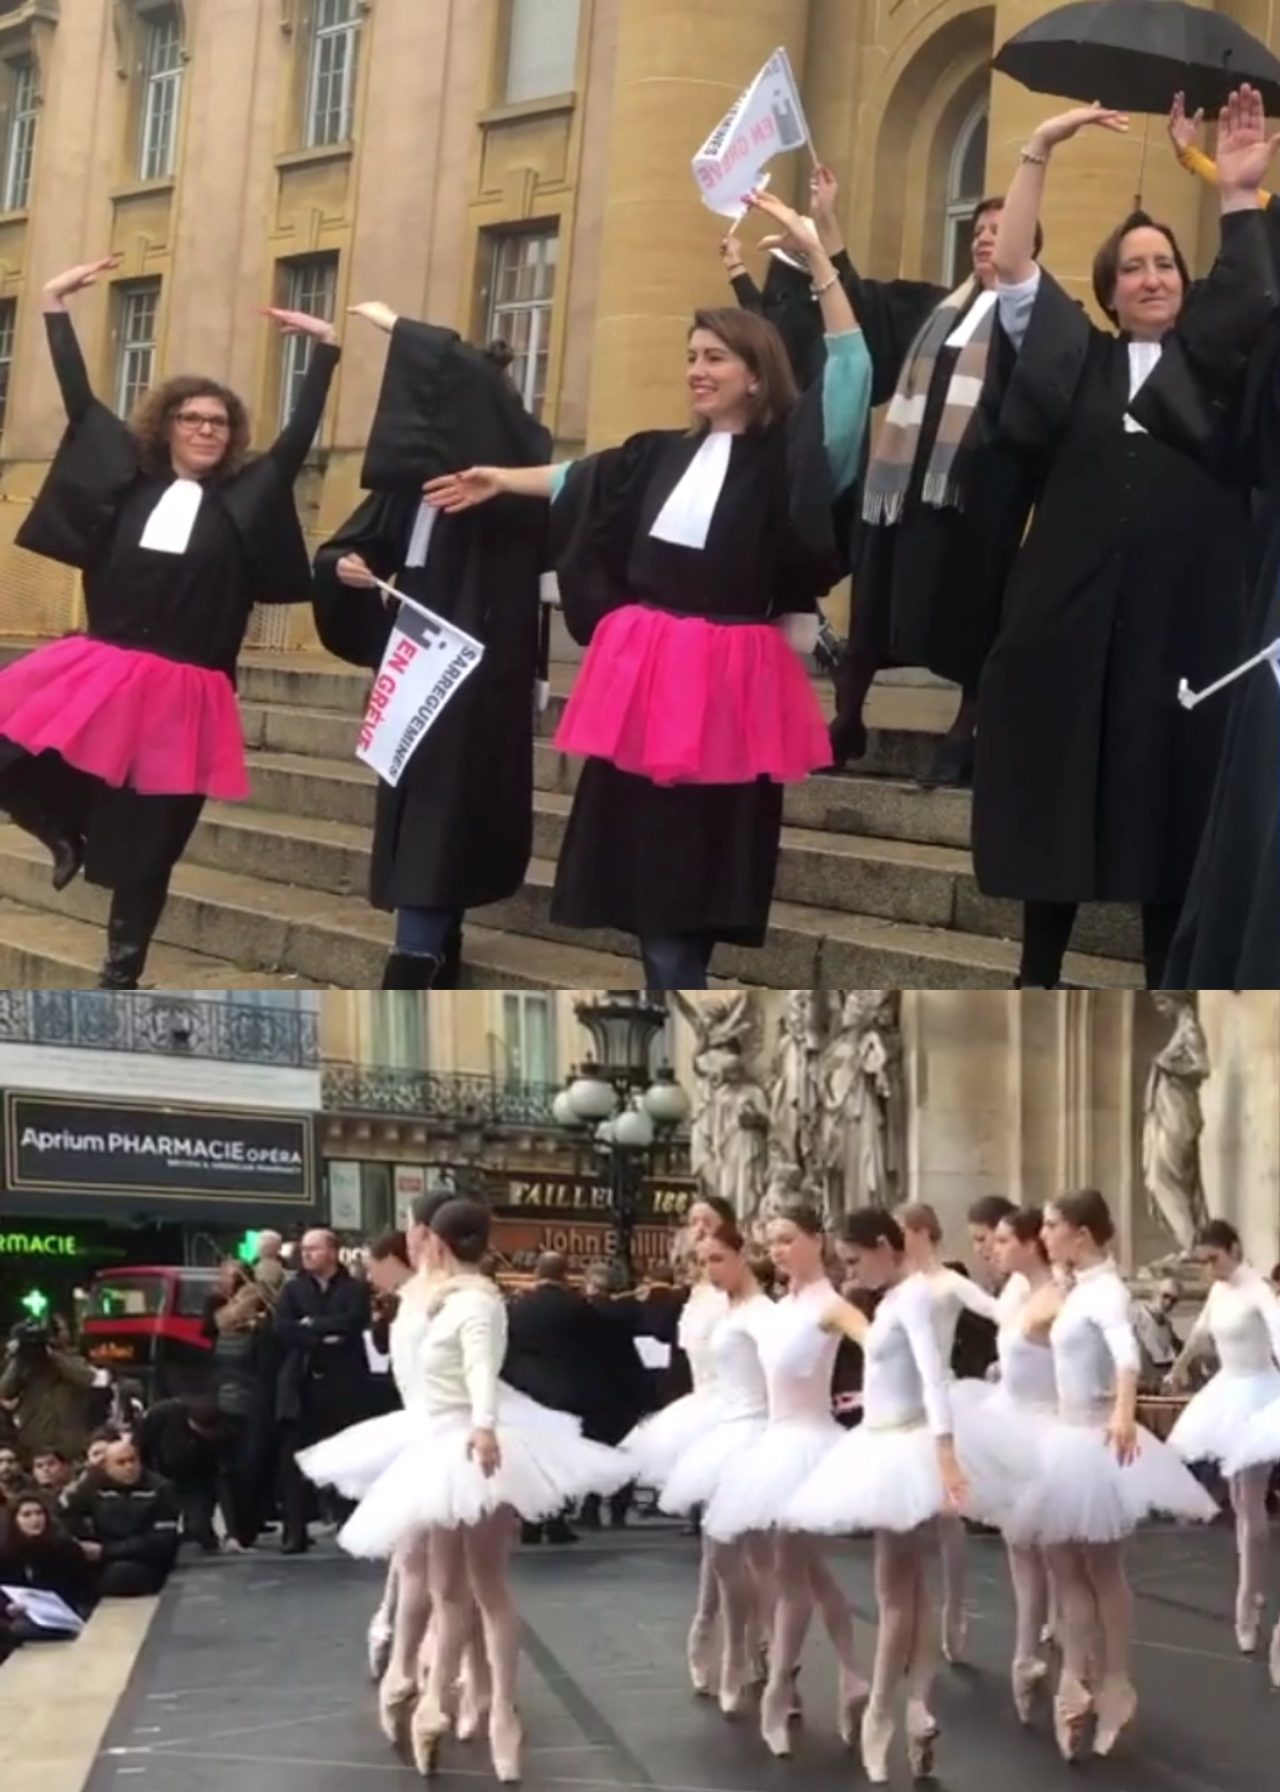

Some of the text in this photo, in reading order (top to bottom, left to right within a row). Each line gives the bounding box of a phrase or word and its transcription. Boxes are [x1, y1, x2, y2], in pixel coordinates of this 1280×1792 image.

[386, 638, 419, 676] EN
[388, 645, 478, 778] SARREGUEMINES
[20, 1127, 105, 1151] Aprium
[107, 1132, 245, 1161] PHARMACIE
[538, 1226, 601, 1255] John
